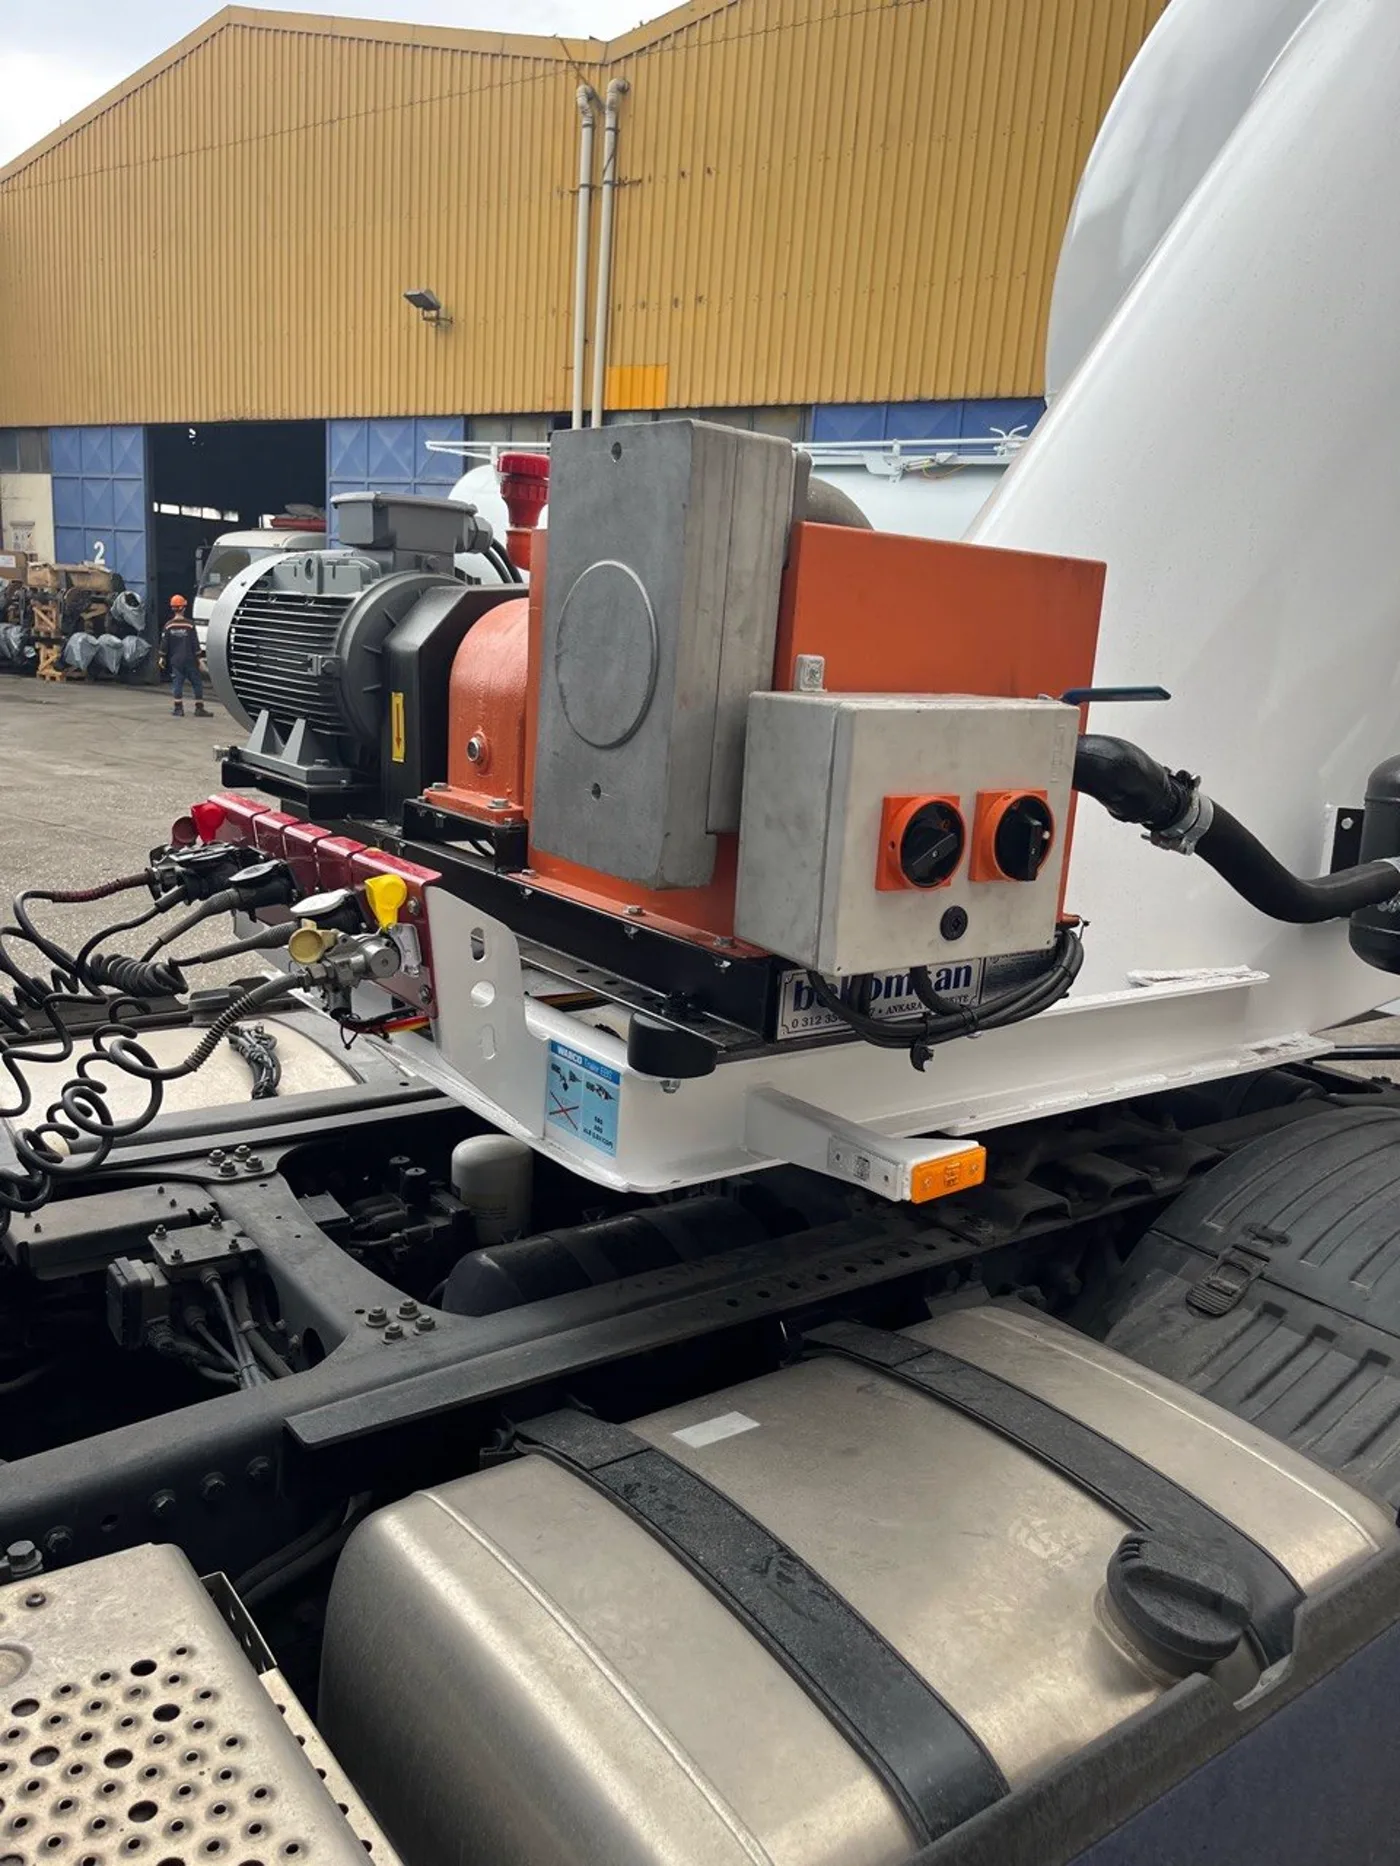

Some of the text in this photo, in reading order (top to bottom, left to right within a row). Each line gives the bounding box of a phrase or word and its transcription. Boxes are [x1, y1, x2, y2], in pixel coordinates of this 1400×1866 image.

[94, 541, 105, 565] 2
[801, 1016, 821, 1027] 312
[886, 1001, 923, 1016] ANKARA
